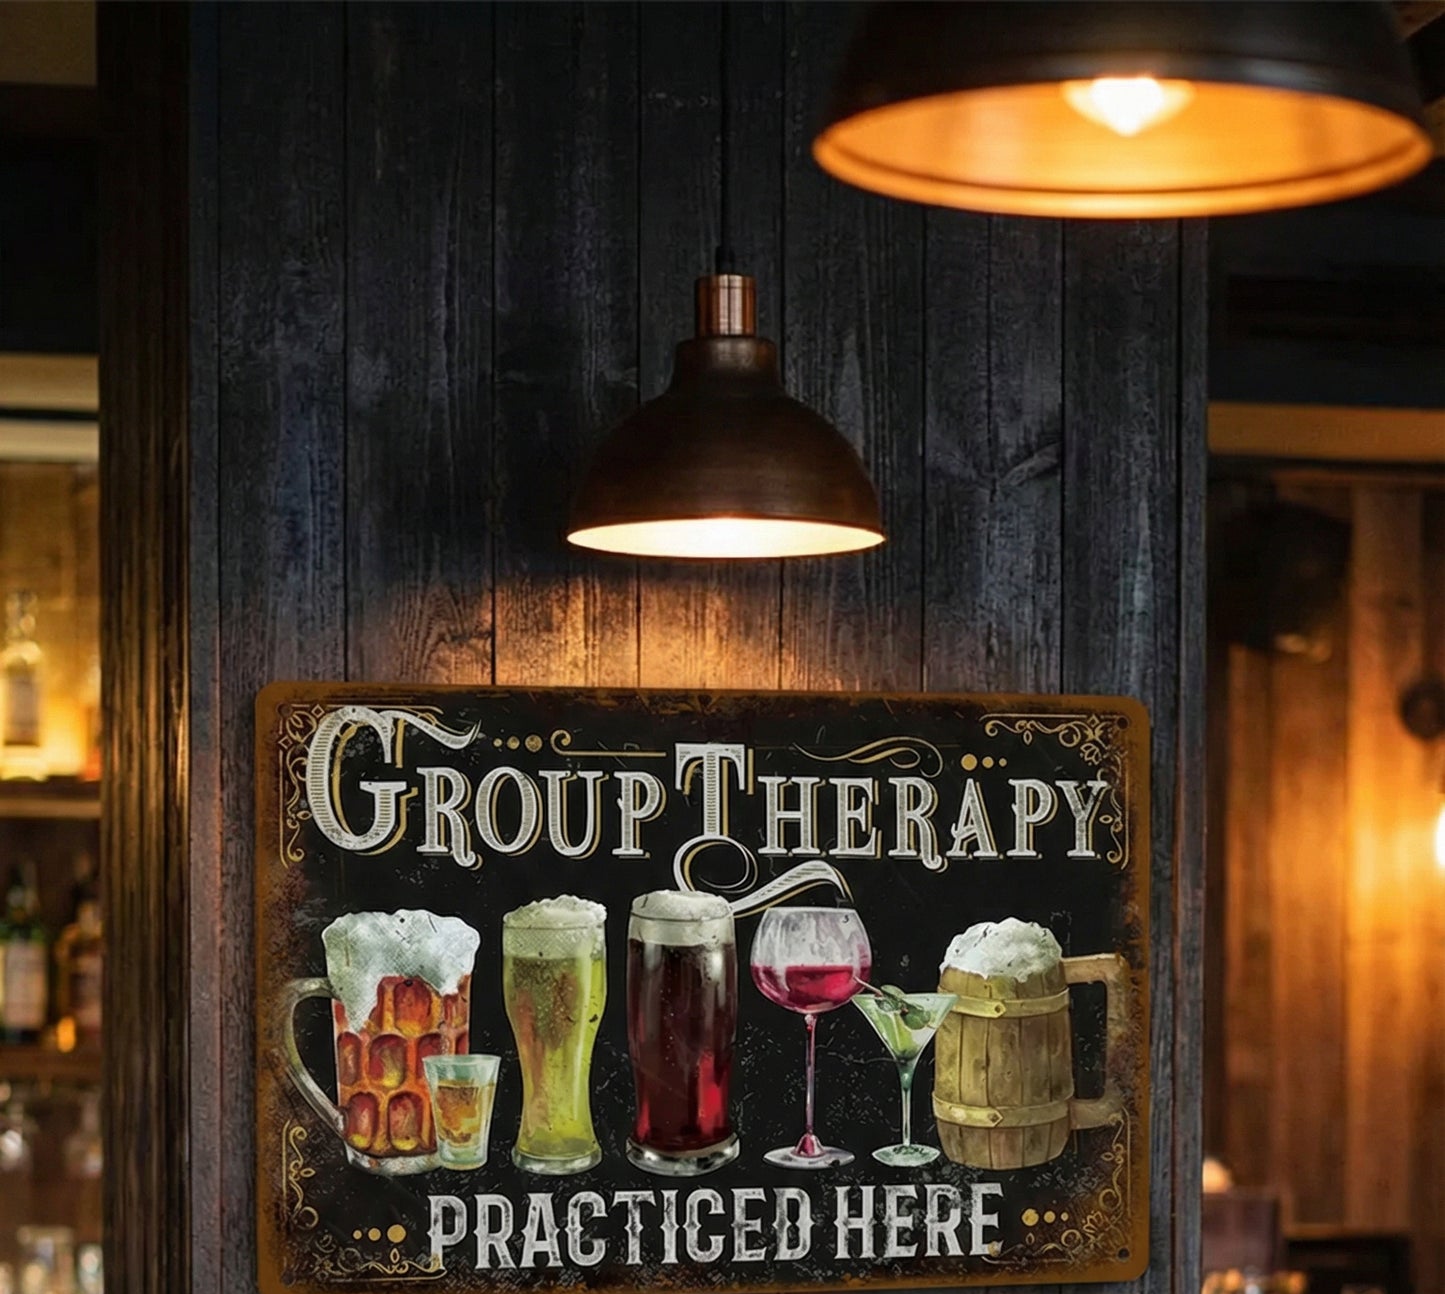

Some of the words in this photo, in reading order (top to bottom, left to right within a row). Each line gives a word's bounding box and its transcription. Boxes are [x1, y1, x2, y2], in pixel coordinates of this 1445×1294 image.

[305, 705, 668, 869] GROUP
[673, 742, 1108, 905] THERAPY
[426, 1187, 815, 1269] PRACTICED
[833, 1182, 1004, 1261] HERE
